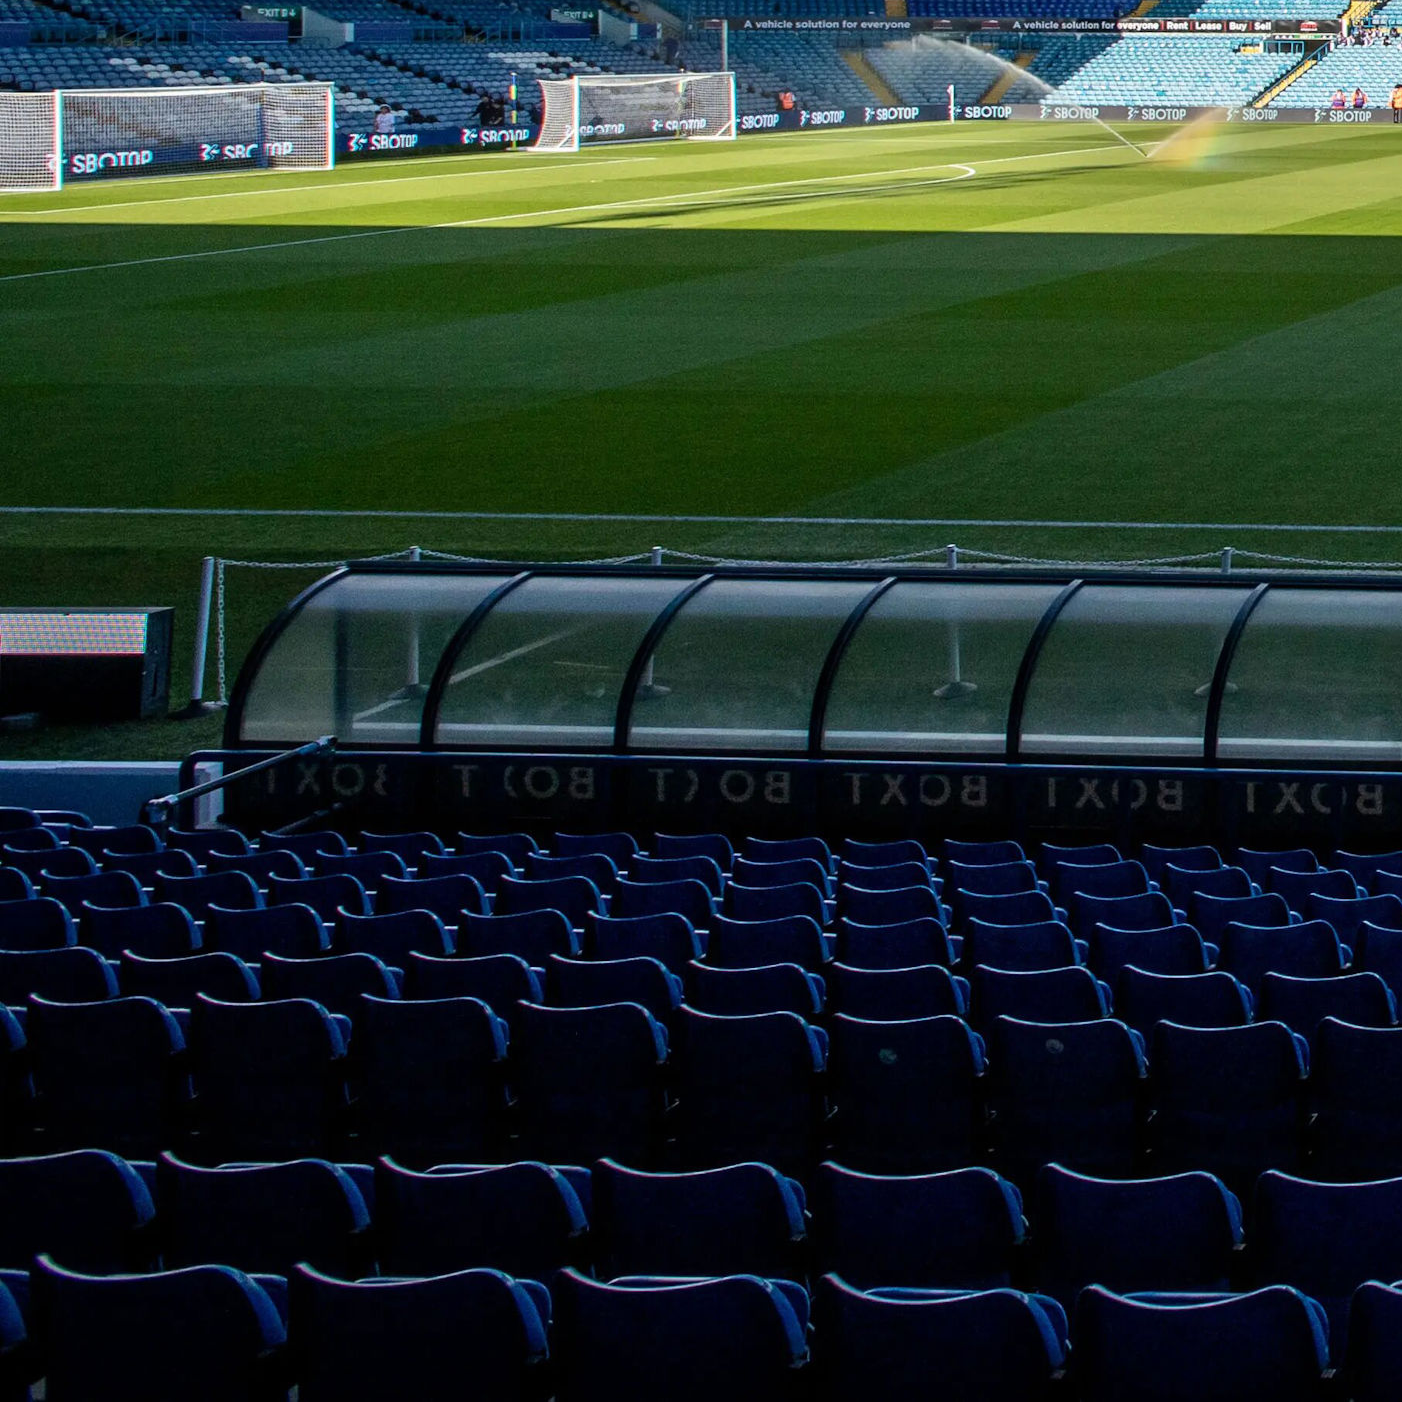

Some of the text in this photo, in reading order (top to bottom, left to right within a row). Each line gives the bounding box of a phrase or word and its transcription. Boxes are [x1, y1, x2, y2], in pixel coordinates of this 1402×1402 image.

[744, 19, 911, 31] A vehicle solution for everyone
[1013, 19, 1272, 32] A vehicle solution for everyone Rent Lease Buy Sell
[811, 111, 846, 126] SBOTOP
[876, 107, 919, 121] SBOTOP
[964, 107, 1013, 119] SBOTOP
[1054, 107, 1100, 119] SBOTOP
[1141, 107, 1187, 120] SBOTOP
[1242, 109, 1279, 120] SBOTOP
[1329, 109, 1372, 123] SBOTOP
[741, 113, 780, 130] SBOTOP
[371, 132, 419, 151] SBOTOP
[72, 149, 153, 174] SBOTOP
